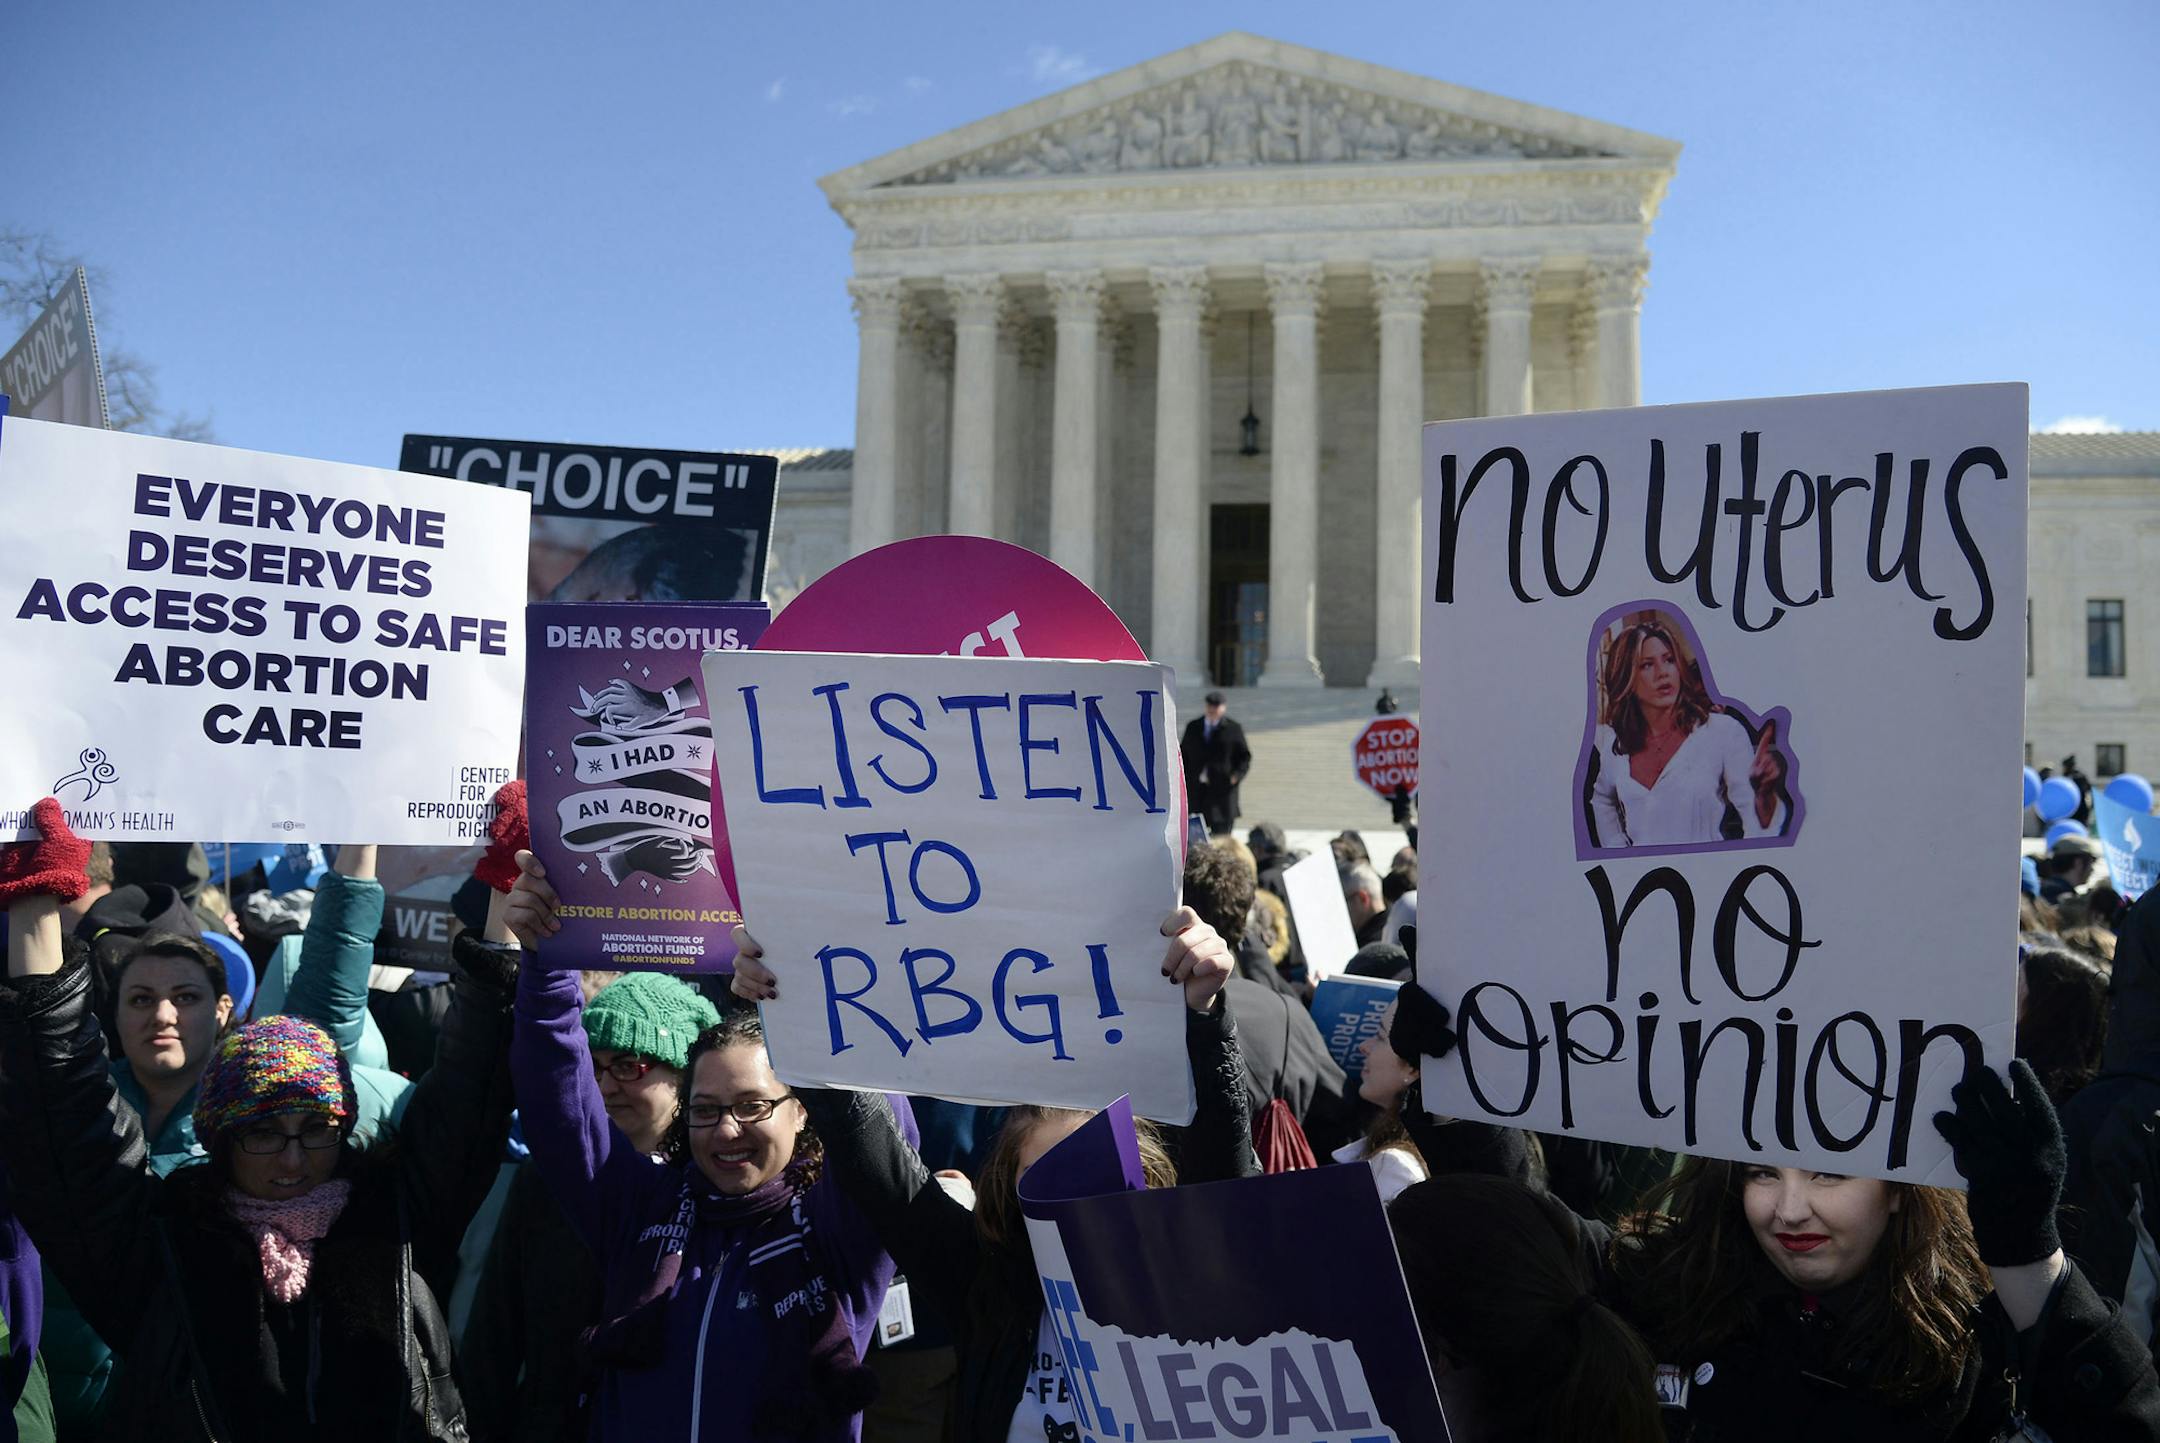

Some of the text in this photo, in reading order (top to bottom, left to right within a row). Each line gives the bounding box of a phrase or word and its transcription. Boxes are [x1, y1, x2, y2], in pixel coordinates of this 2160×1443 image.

[429, 445, 750, 518] "CHOICE"
[133, 473, 446, 549] EVERYONE
[1435, 431, 2008, 641] no uterus
[127, 530, 432, 599] DESERVES
[16, 578, 507, 656] ACCESS TO SAFE
[546, 625, 748, 650] DEAR SCOTUS,
[114, 642, 430, 701] ABORTION
[202, 703, 363, 749] CARE
[1366, 728, 1417, 750] STOP
[611, 743, 675, 770] I HAD
[737, 682, 1166, 813] LISTEN
[1358, 747, 1418, 768] ABORTIO
[460, 766, 510, 784] CENTER
[1370, 767, 1419, 787] NOW
[459, 785, 486, 801] FOR
[0, 810, 175, 831] WHOL OMAN'S HEALTH
[578, 799, 710, 829] AN ABORTIO
[457, 821, 492, 838] RIGH
[845, 829, 981, 925] TO
[554, 905, 614, 919] ESTORE
[617, 907, 696, 922] ABORTION
[601, 933, 705, 945] NATIONAL NETWORK OF
[601, 942, 705, 956] ABORTION FUNDS
[1584, 864, 1822, 1006] no
[612, 954, 696, 966] @ABORTIONFUNDS
[815, 943, 1124, 1061] RBG!
[1456, 980, 1985, 1170] opinion
[1116, 1341, 1373, 1441] LEGAL
